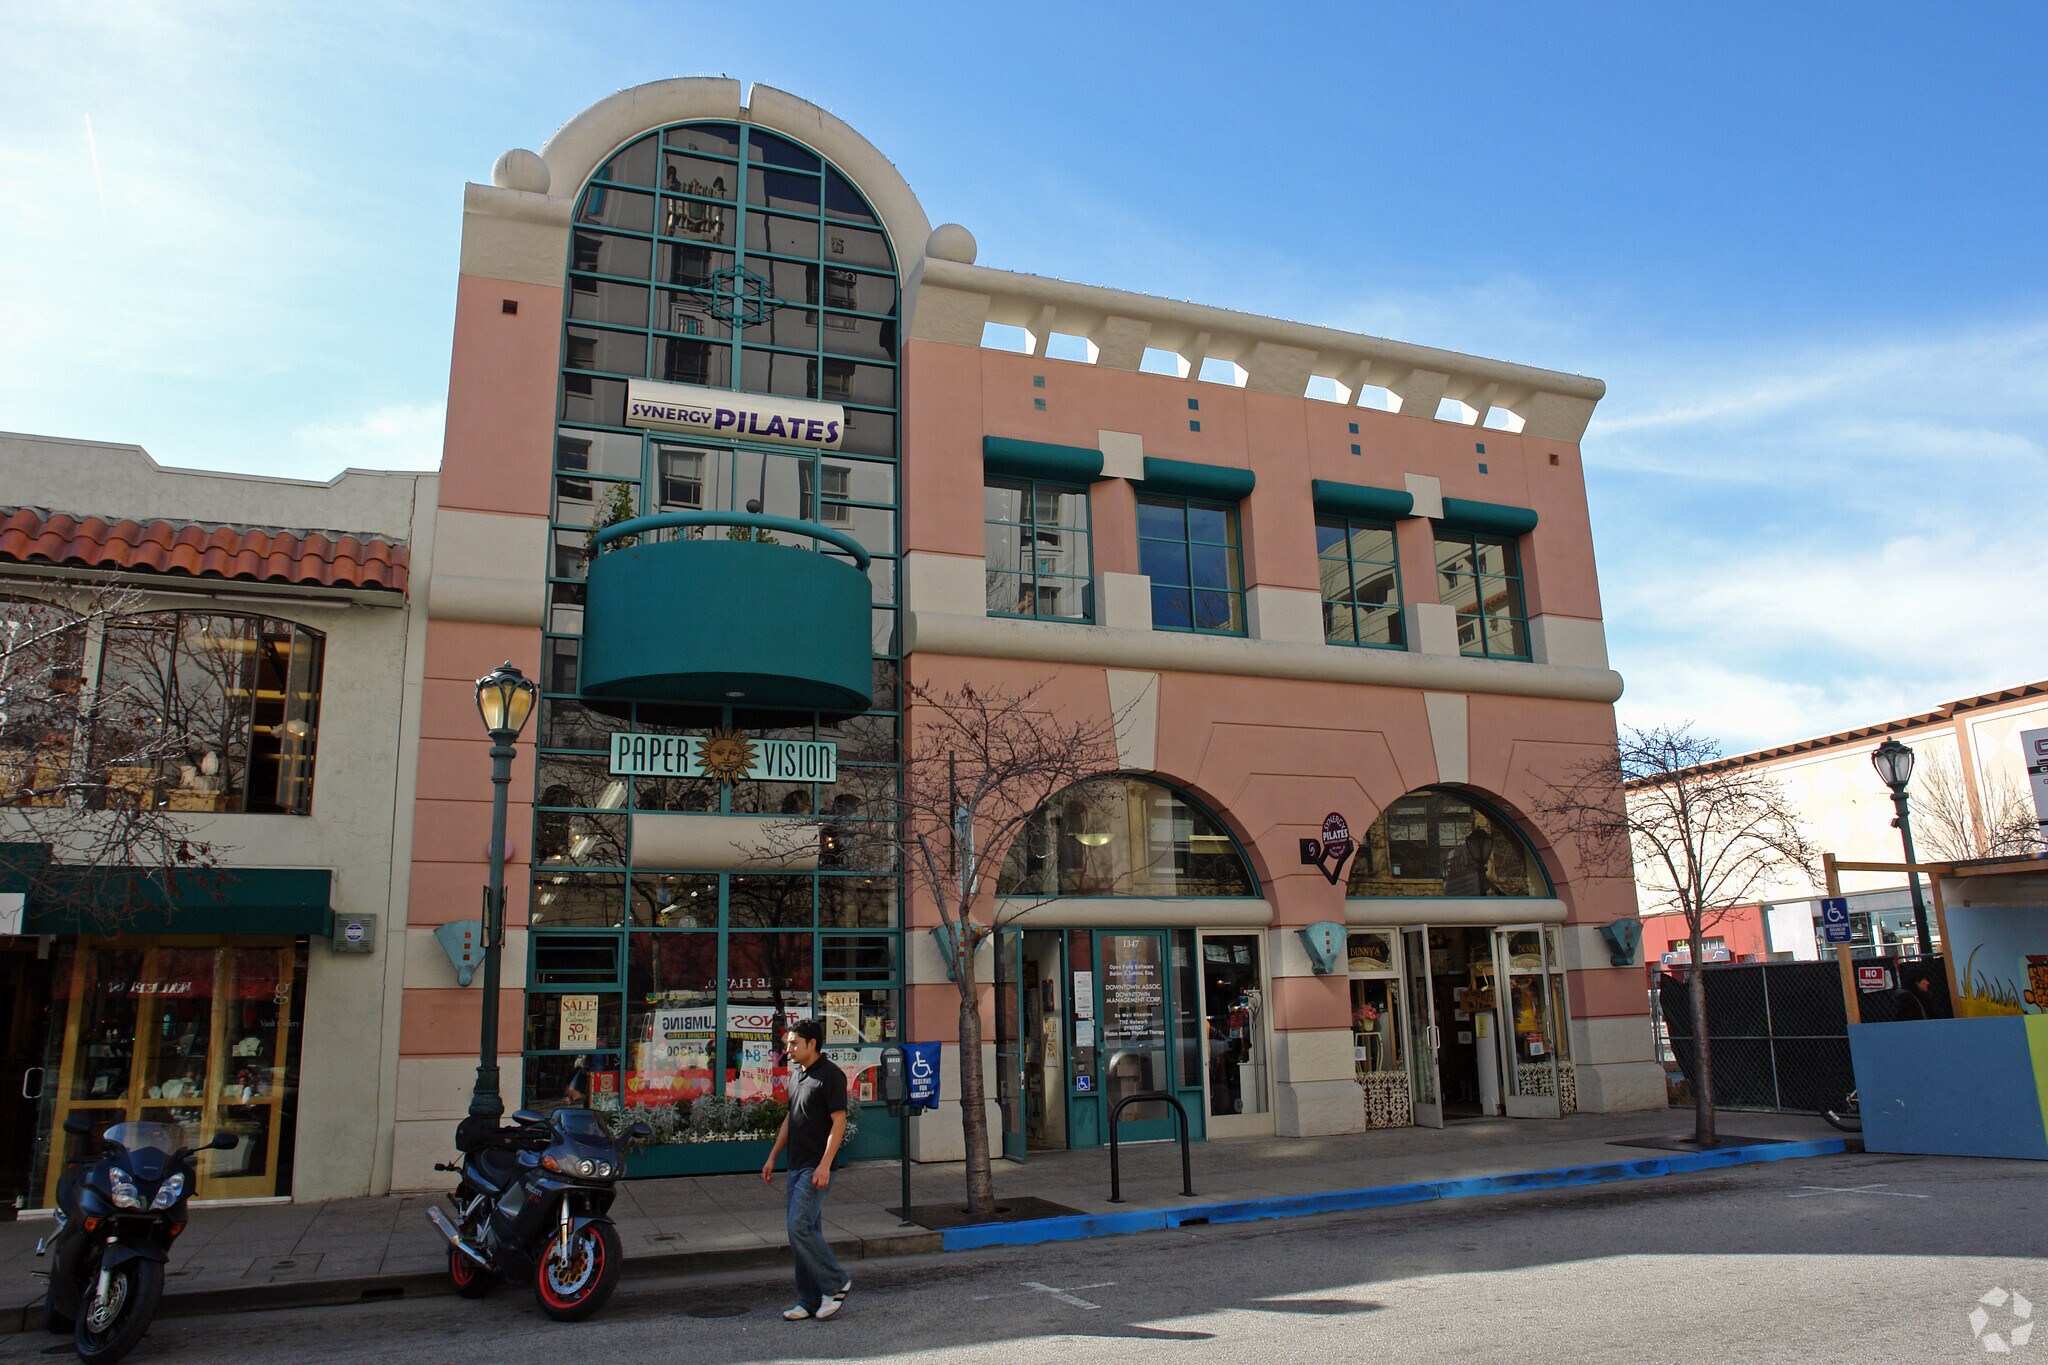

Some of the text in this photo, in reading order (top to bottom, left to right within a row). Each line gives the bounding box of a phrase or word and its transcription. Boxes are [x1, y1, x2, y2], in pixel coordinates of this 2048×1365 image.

[632, 403, 840, 444] SYNERGY PILATES
[618, 736, 830, 779] PAPER VISION
[1324, 815, 1346, 831] SYNERGY
[1322, 829, 1348, 841] PILATES
[1123, 940, 1139, 948] 1347
[1865, 970, 1877, 978] NO
[563, 1000, 597, 1011] SALE!
[829, 998, 858, 1007] SALE!
